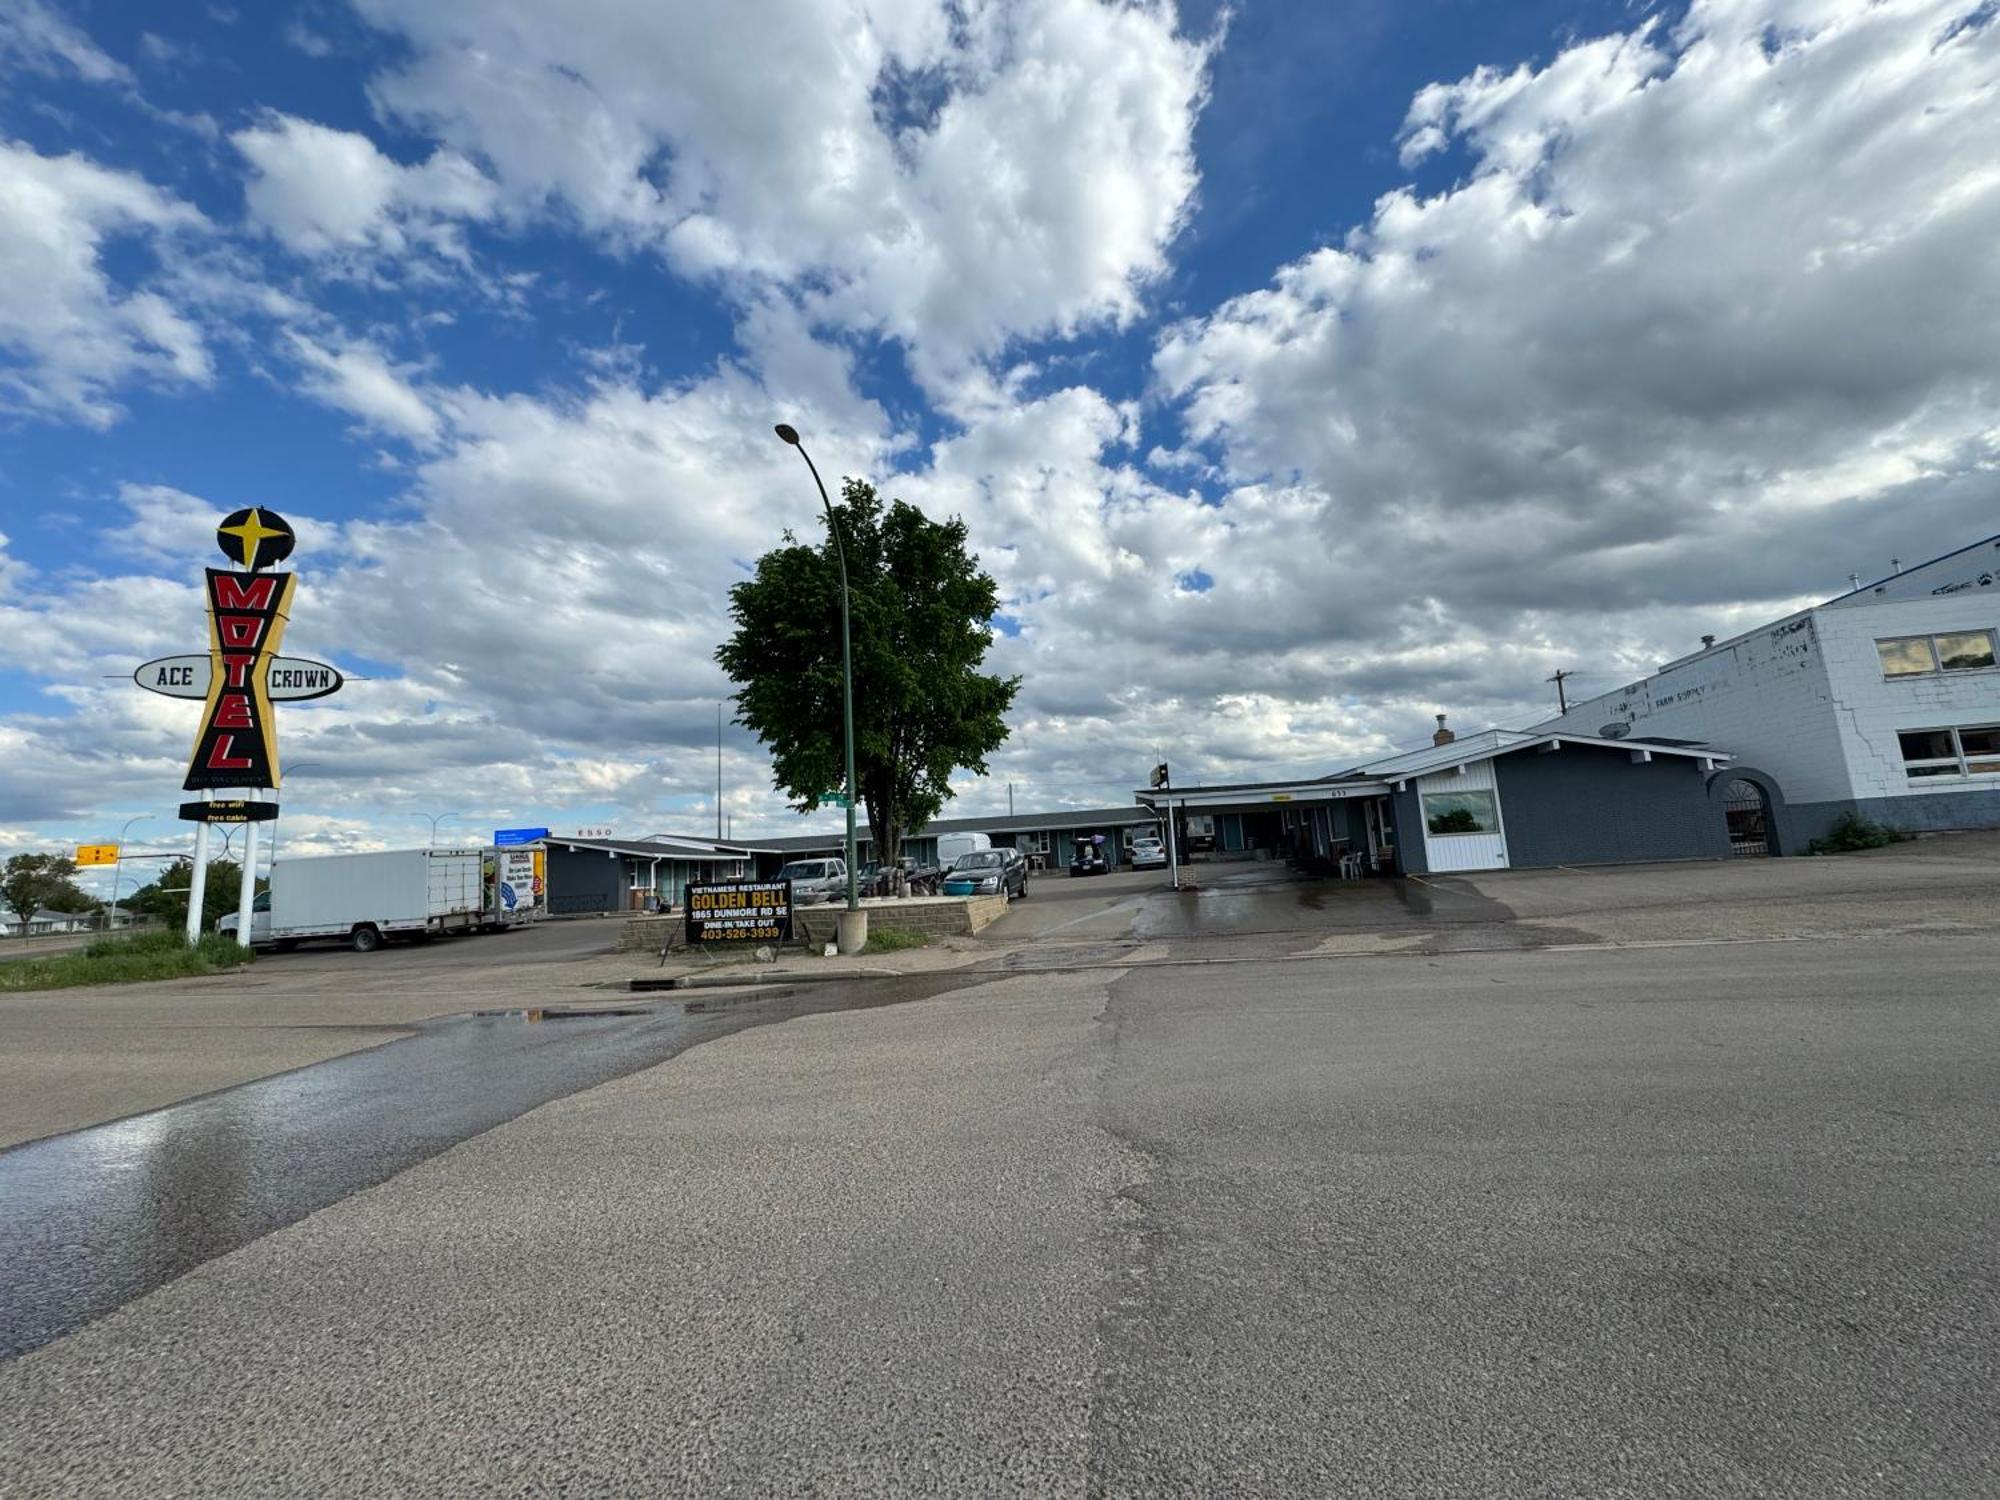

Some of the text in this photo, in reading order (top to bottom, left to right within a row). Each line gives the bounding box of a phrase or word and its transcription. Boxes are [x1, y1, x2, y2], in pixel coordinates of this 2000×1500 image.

[157, 666, 193, 686] ACE
[207, 575, 277, 768] MOTEL
[271, 669, 330, 689] CROWN
[577, 828, 612, 837] ESSO
[692, 882, 786, 894] VIETNAMESE RESTAURANT
[692, 890, 787, 909] GOLDEN BELL
[714, 908, 758, 918] DUNMORE
[760, 907, 773, 916] RD
[776, 906, 787, 915] SE
[757, 919, 774, 927] OUT
